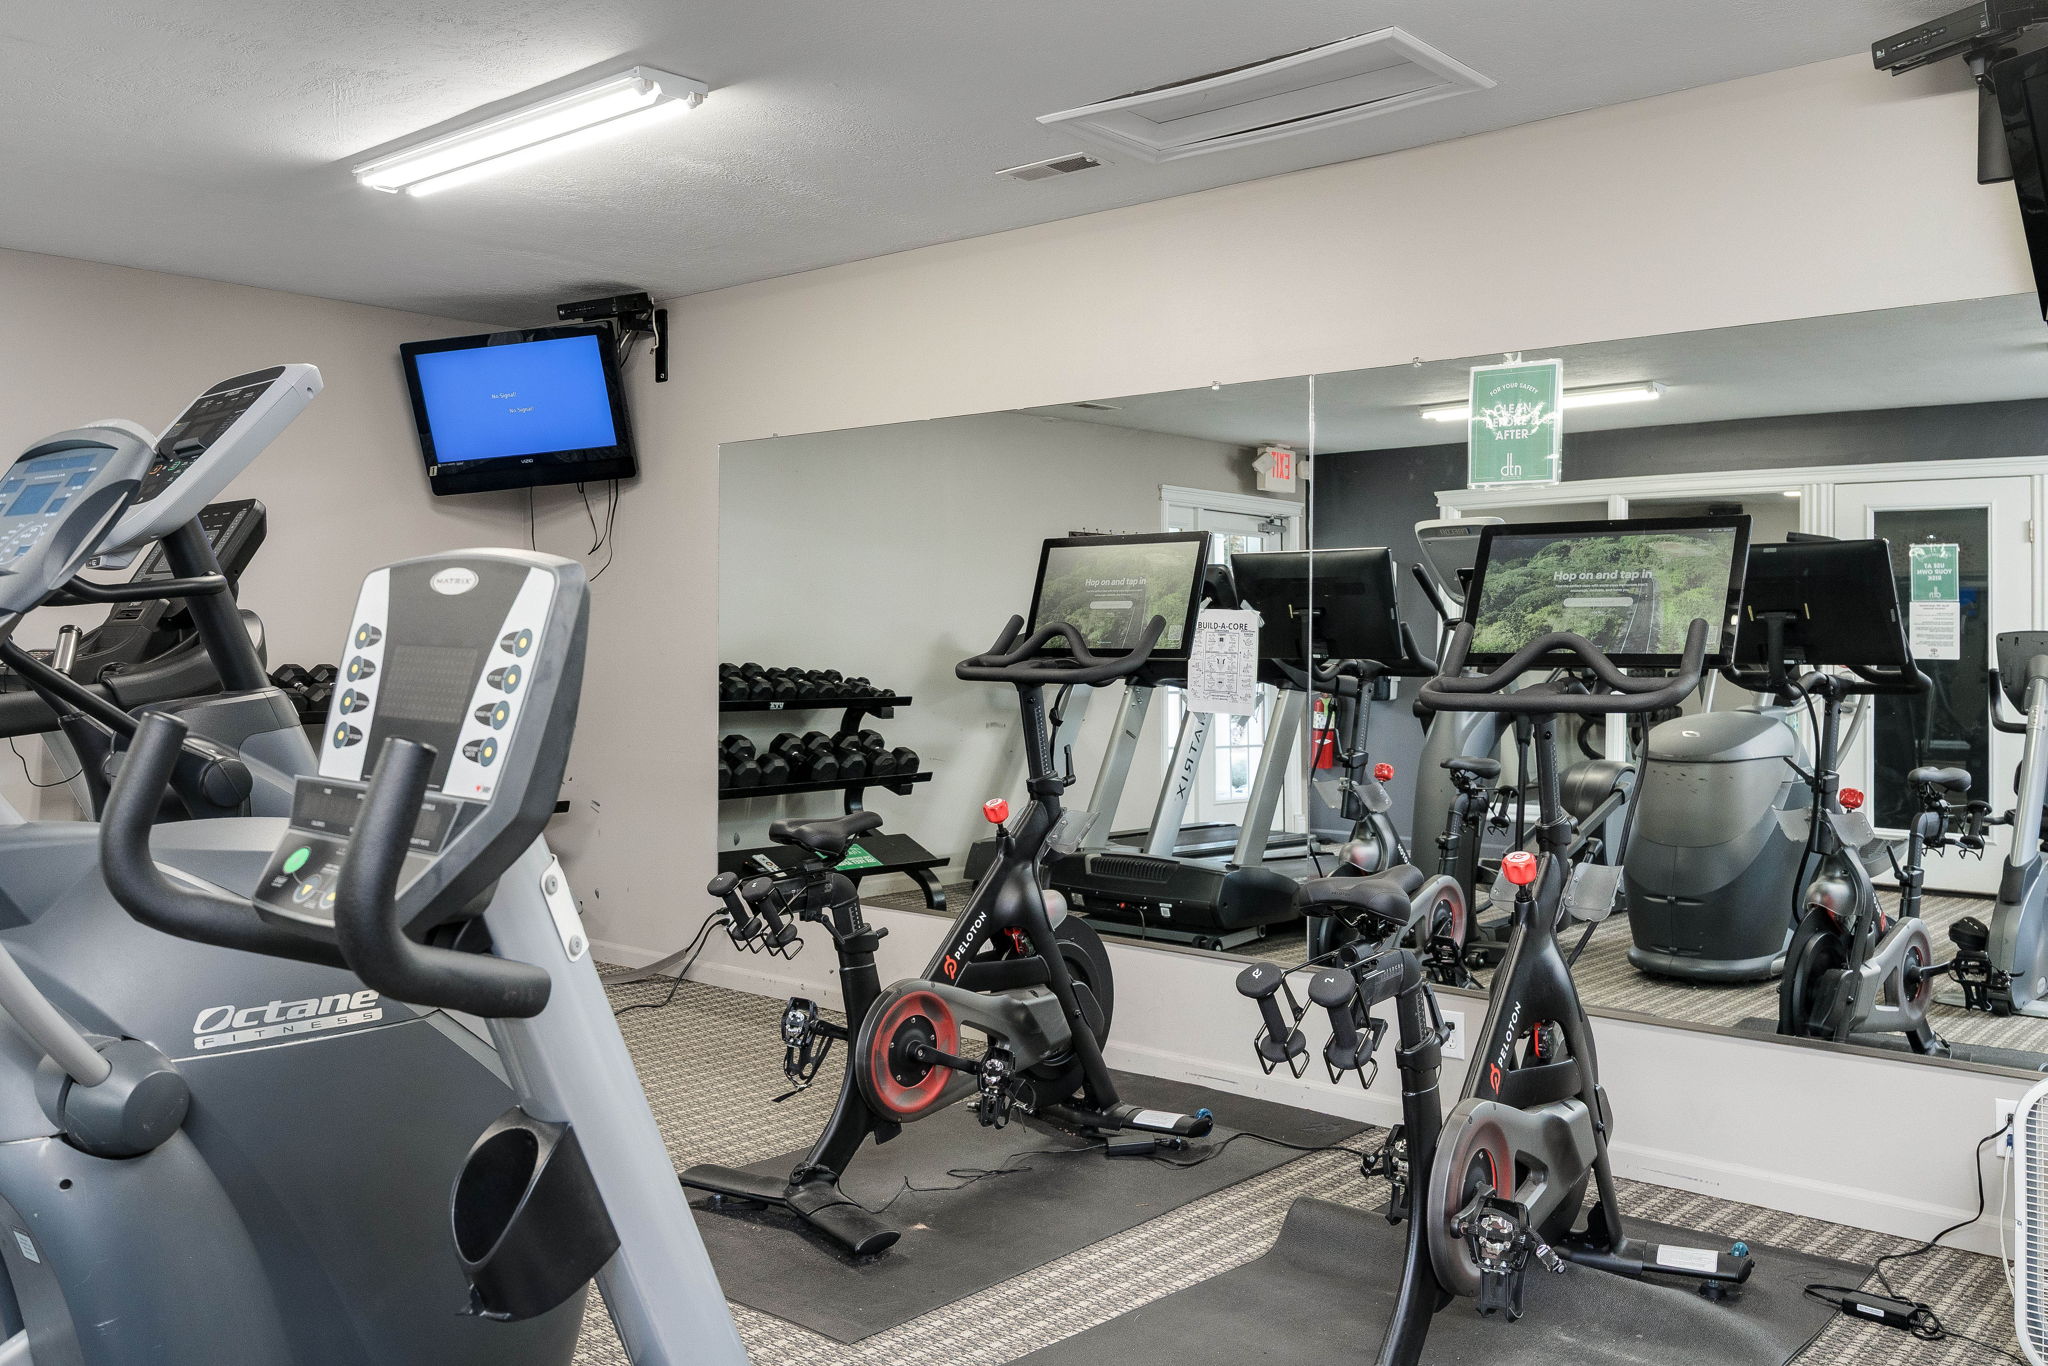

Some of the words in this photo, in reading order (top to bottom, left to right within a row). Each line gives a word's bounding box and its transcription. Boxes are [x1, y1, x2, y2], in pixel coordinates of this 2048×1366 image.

[1489, 387, 1501, 397] FOR
[1519, 383, 1539, 394] SAFETY
[1495, 429, 1529, 440] AFTER
[436, 577, 471, 585] MATRIX
[1085, 578, 1100, 588] Hop
[1110, 577, 1126, 586] and
[1126, 578, 1139, 587] tap
[1138, 576, 1147, 585] in
[1553, 571, 1577, 582] Hop
[1578, 572, 1594, 580] on
[1595, 570, 1618, 580] and
[1620, 570, 1640, 580] tap
[1641, 569, 1653, 579] in
[1197, 621, 1248, 631] BUILD-A-CORE
[954, 911, 987, 960] PELOTON
[193, 989, 380, 1035] Octane
[202, 1011, 373, 1047] FITNESS
[1497, 1001, 1522, 1069] PELOTON
